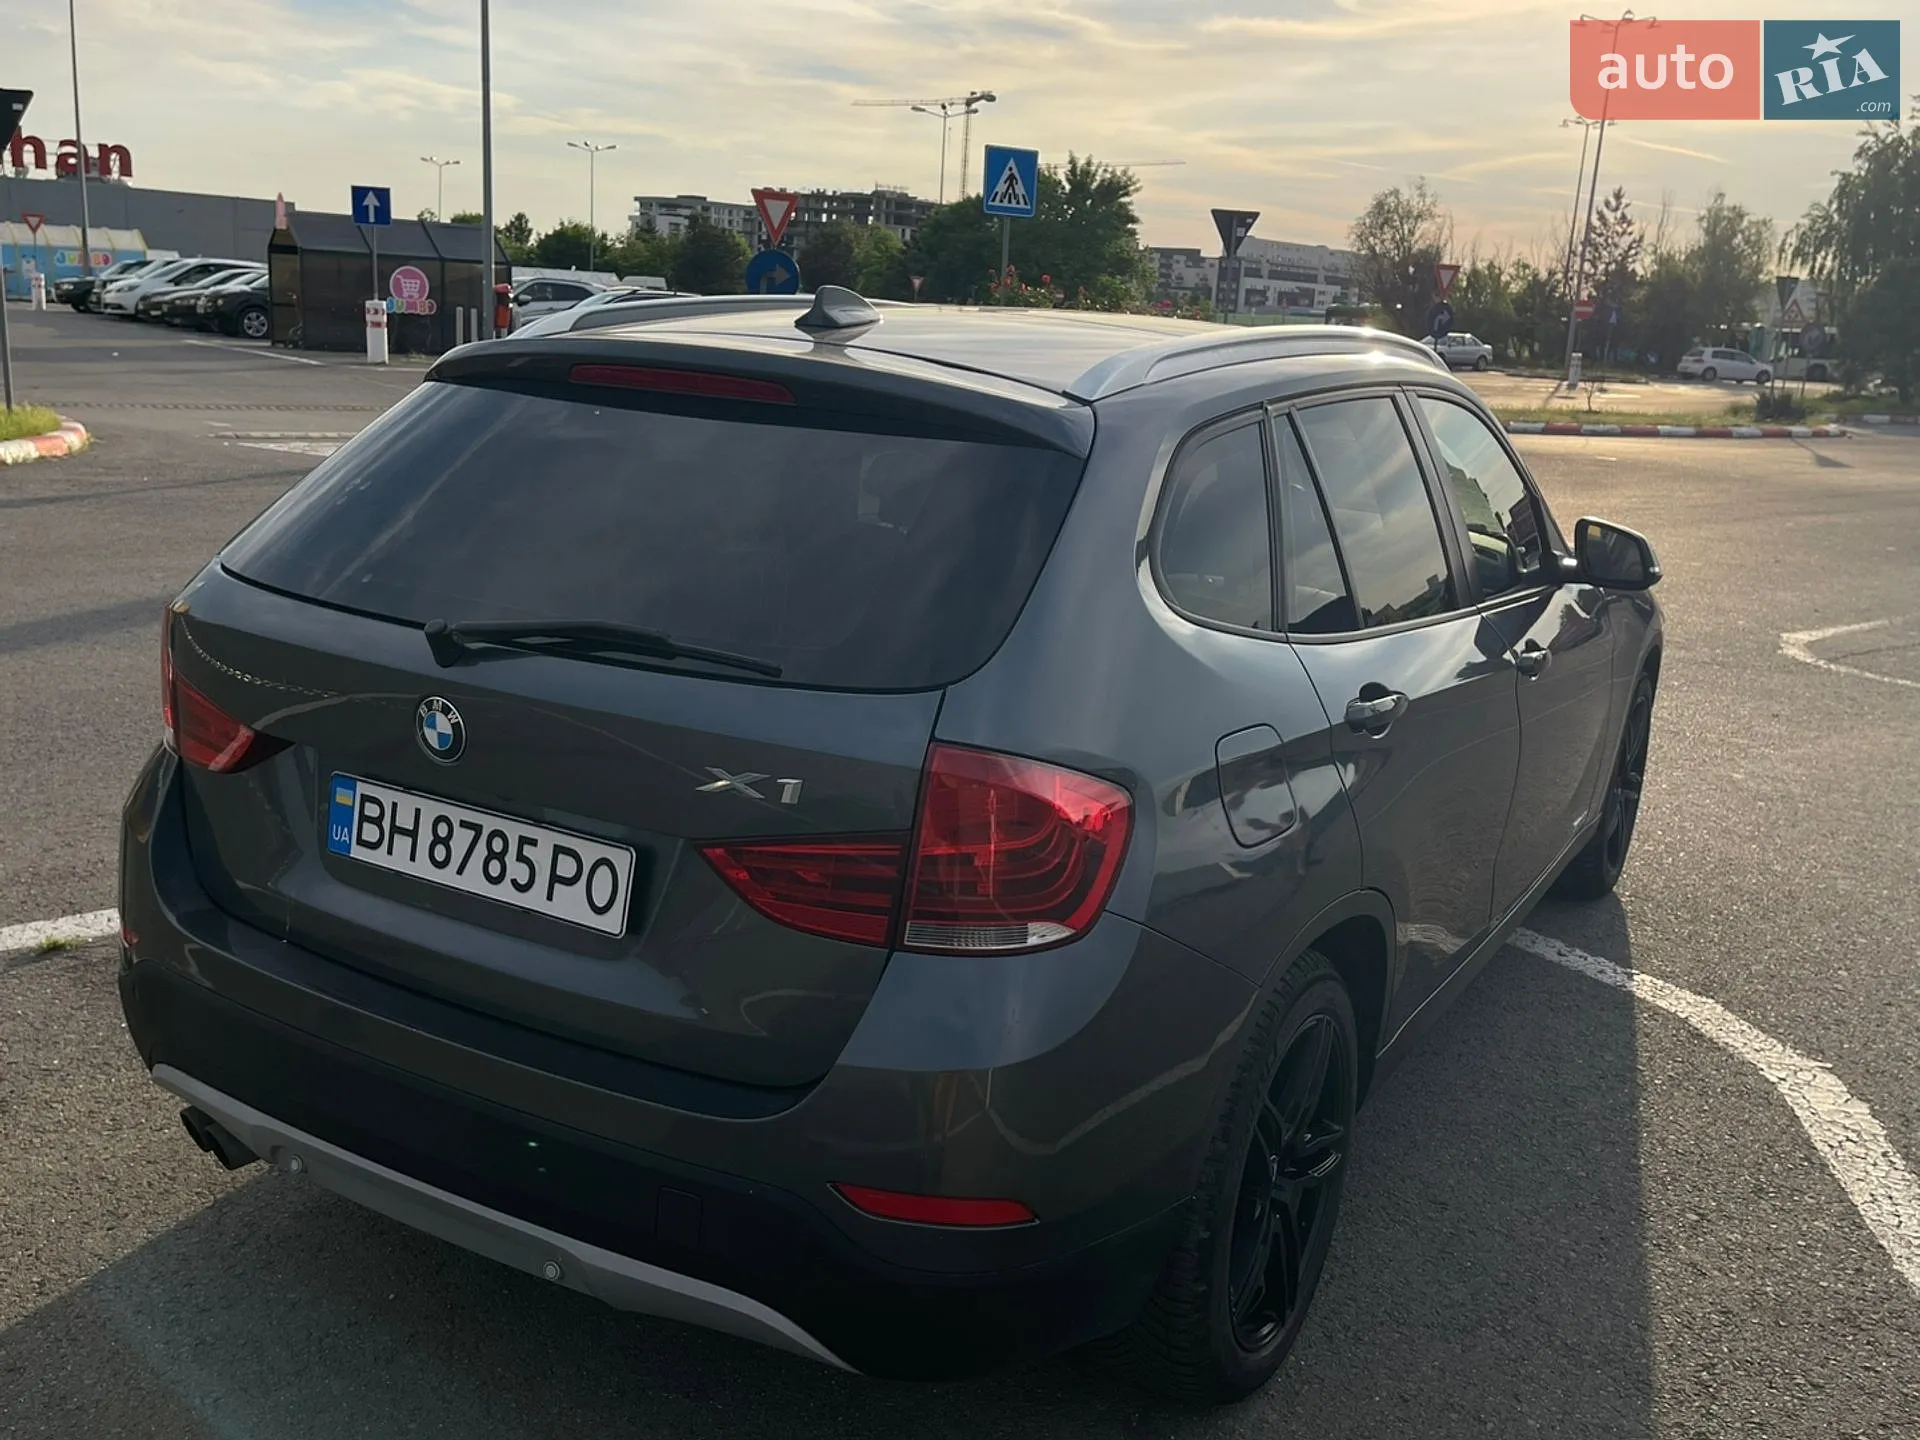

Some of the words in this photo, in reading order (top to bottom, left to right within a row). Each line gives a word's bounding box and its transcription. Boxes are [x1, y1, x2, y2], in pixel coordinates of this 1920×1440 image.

[419, 700, 459, 724] BMW
[695, 766, 803, 804] X1
[332, 824, 349, 844] UA
